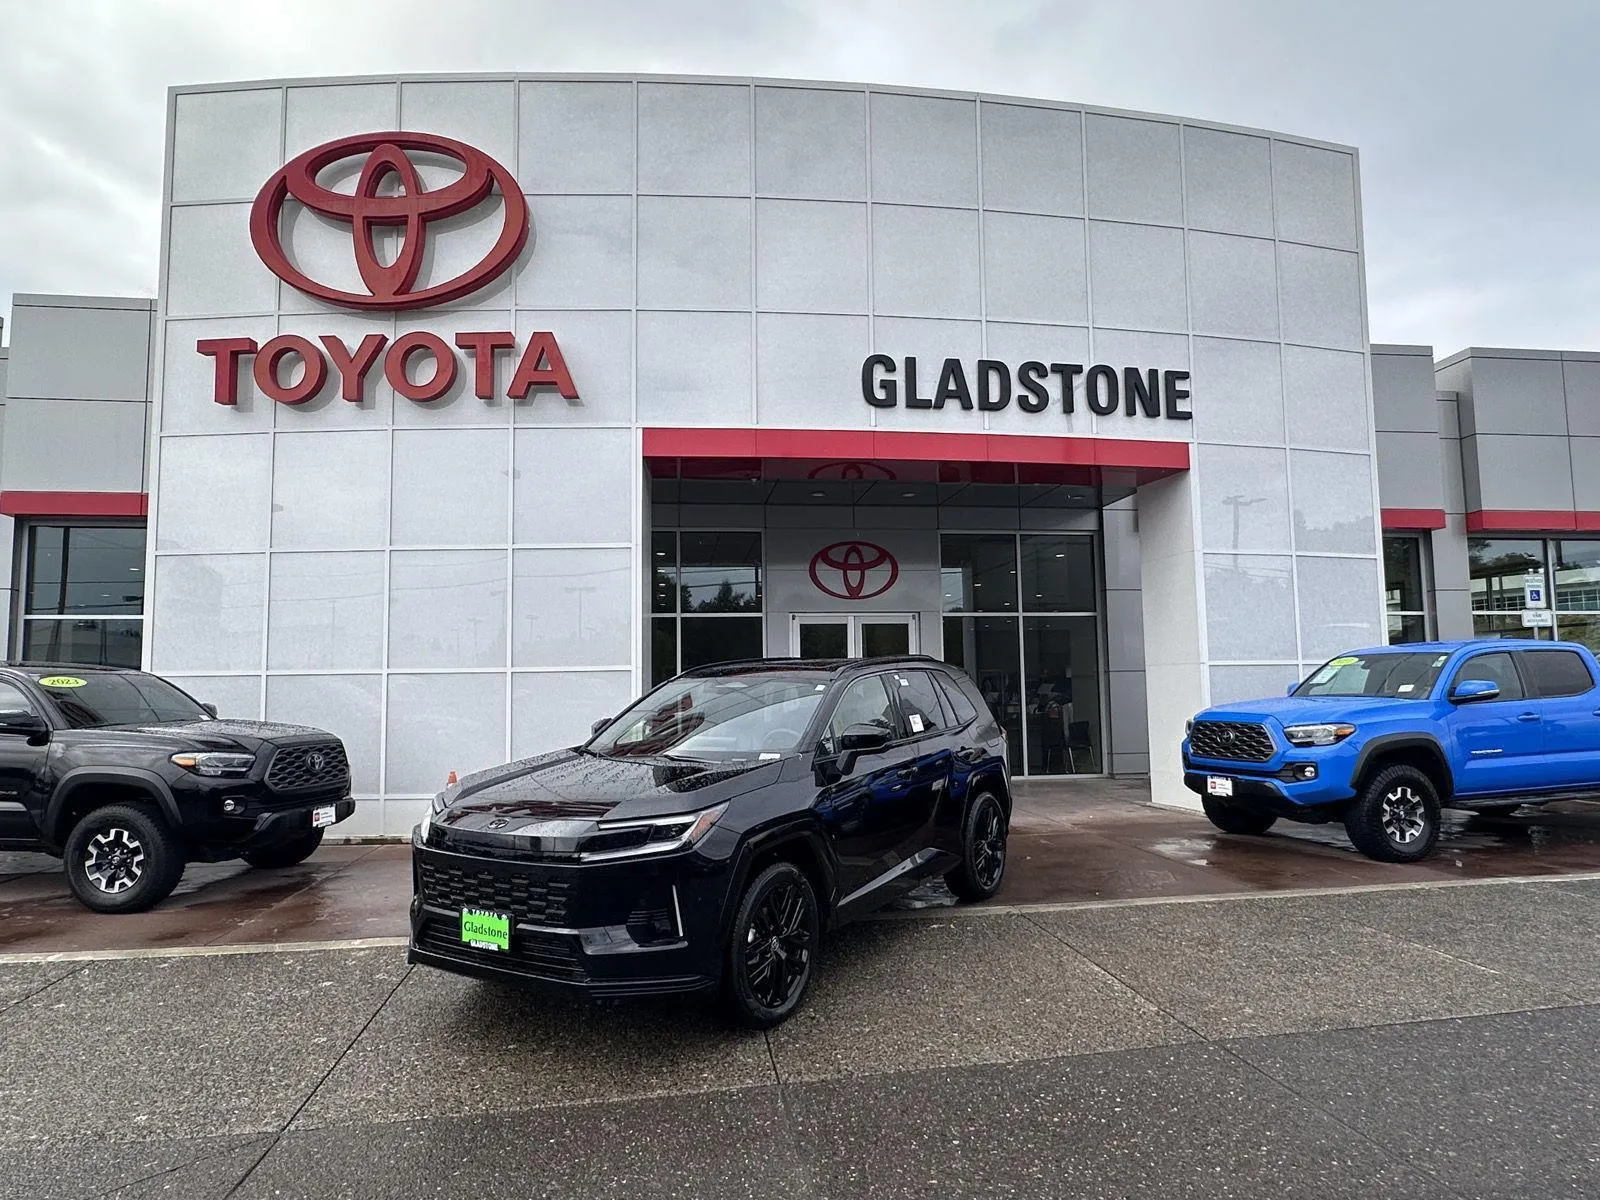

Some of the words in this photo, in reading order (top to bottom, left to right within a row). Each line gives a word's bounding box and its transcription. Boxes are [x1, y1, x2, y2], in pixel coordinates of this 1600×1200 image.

[197, 331, 580, 406] TOYOTA
[861, 354, 1193, 421] GLADSTONE
[463, 921, 508, 939] Gladstone
